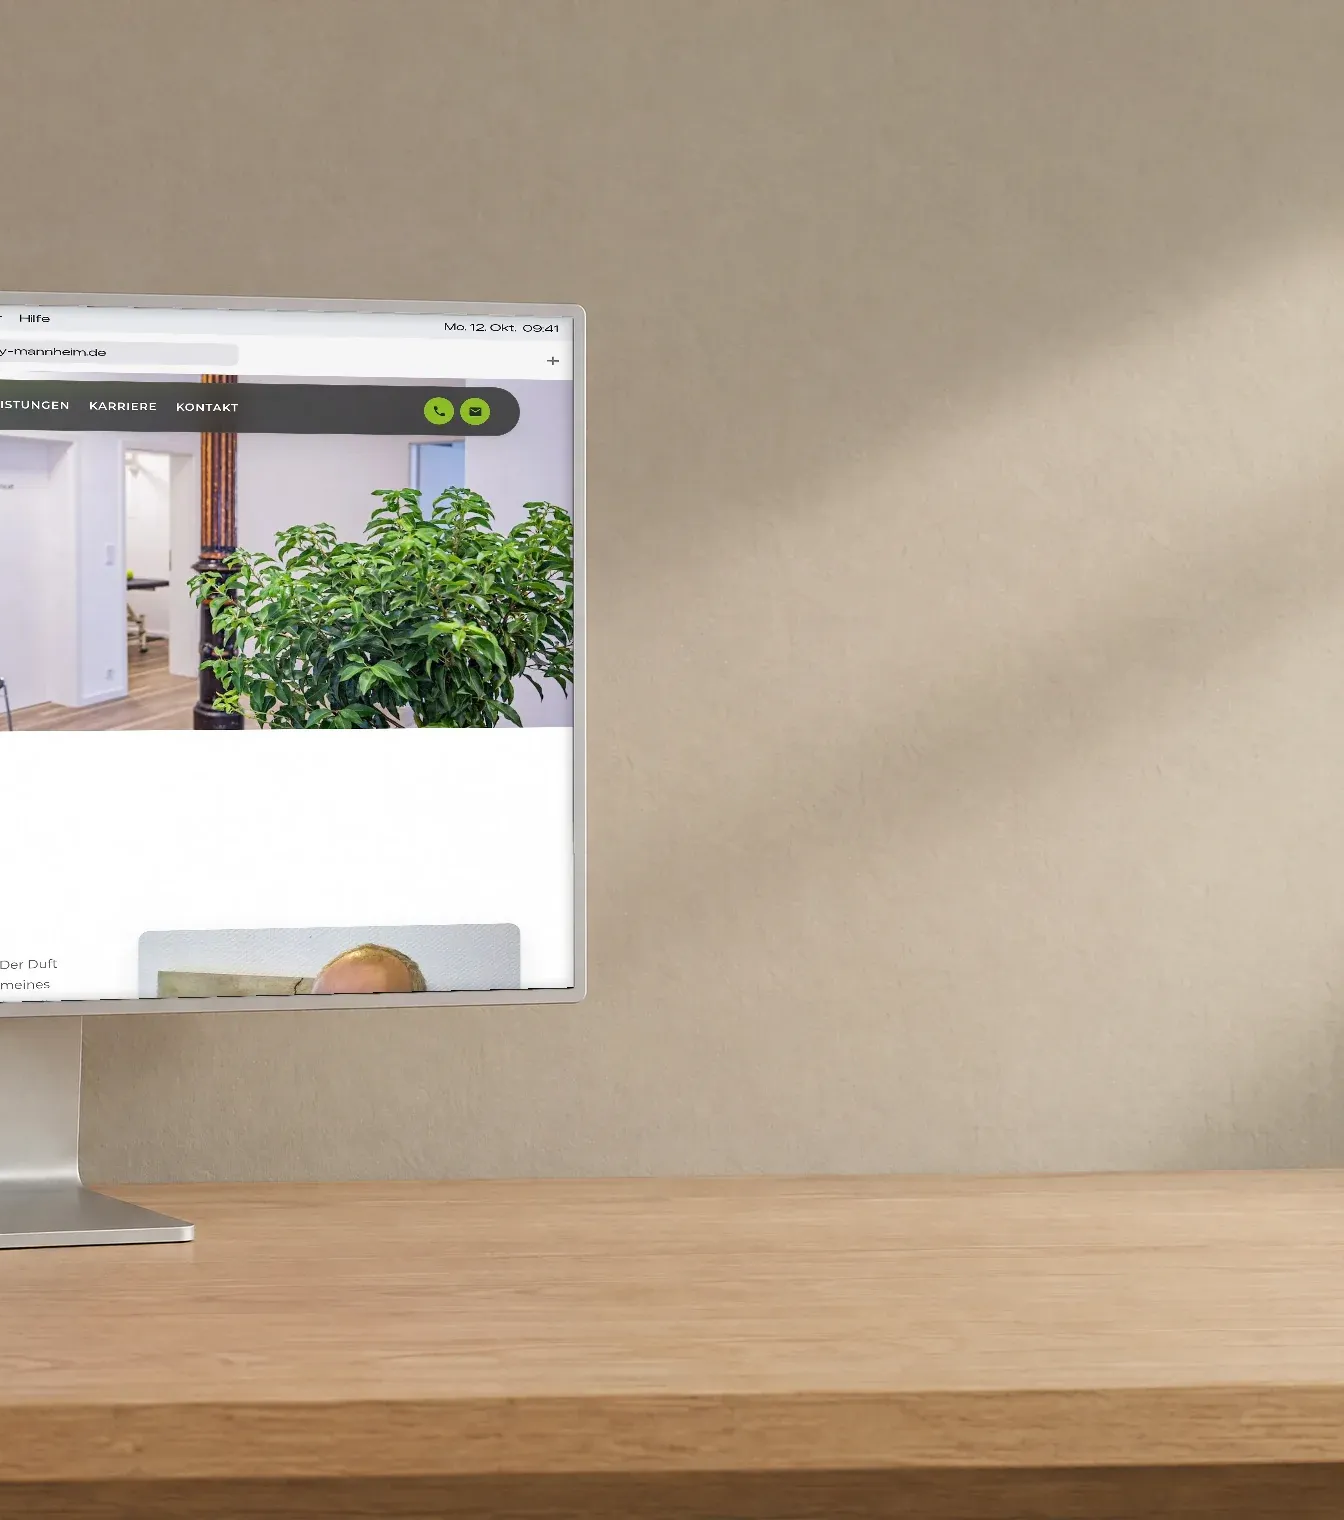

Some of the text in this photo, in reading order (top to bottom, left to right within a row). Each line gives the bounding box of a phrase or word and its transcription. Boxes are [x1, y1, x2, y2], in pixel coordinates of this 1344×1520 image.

[19, 313, 51, 323] Hilfe
[444, 322, 559, 333] Mo. 12. Okt. 09:41
[89, 401, 157, 411] KARRIERE
[176, 402, 239, 413] KONTAKT
[0, 960, 24, 970] Der
[28, 958, 58, 970] Duft
[0, 979, 51, 991] meines
